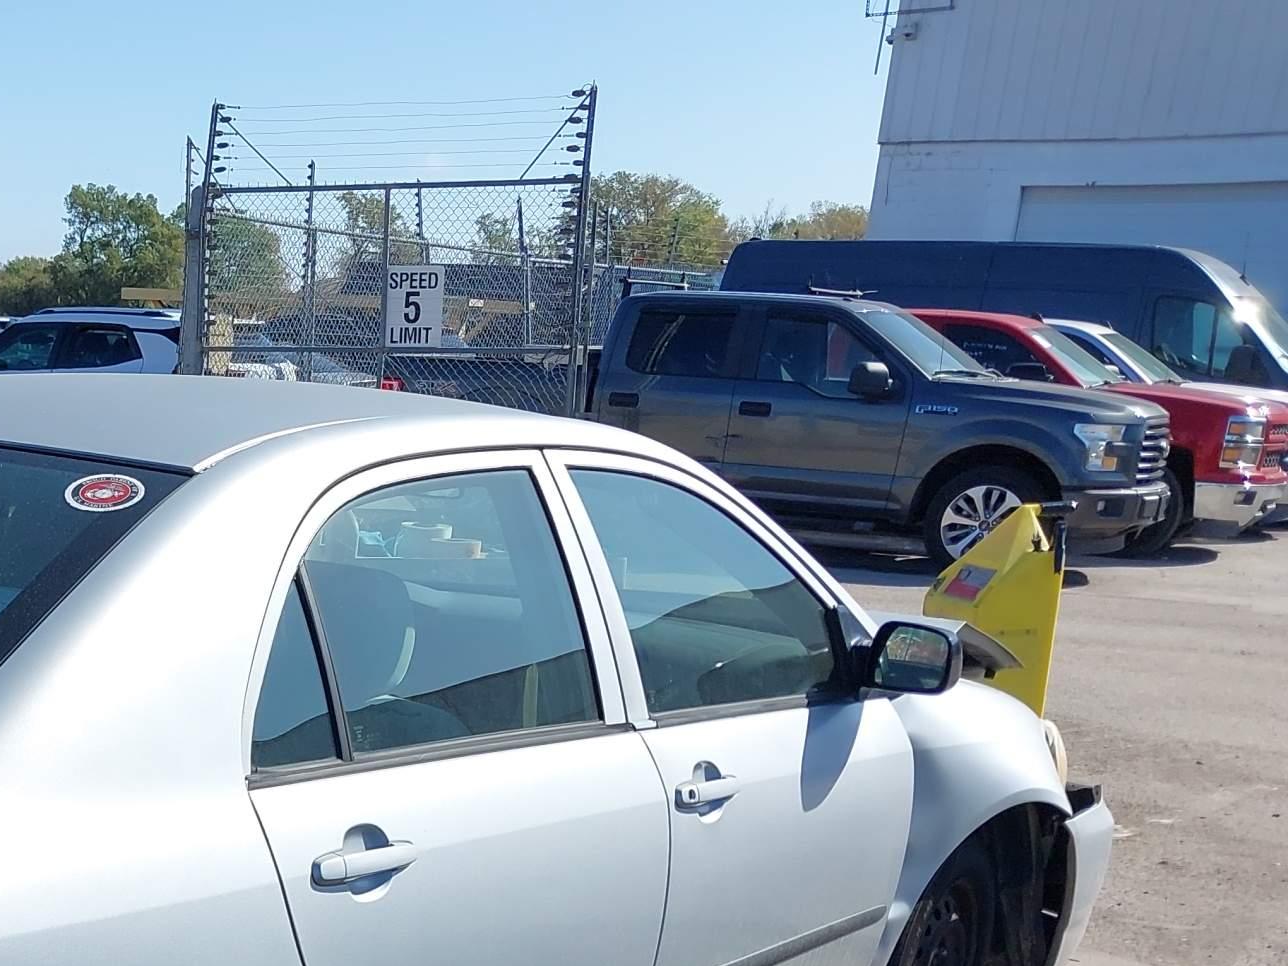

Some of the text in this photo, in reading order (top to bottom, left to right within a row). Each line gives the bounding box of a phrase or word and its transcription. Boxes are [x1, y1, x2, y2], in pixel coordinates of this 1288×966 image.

[389, 271, 439, 290] SPEED
[403, 291, 421, 324] 5
[389, 327, 432, 344] LIMIT
